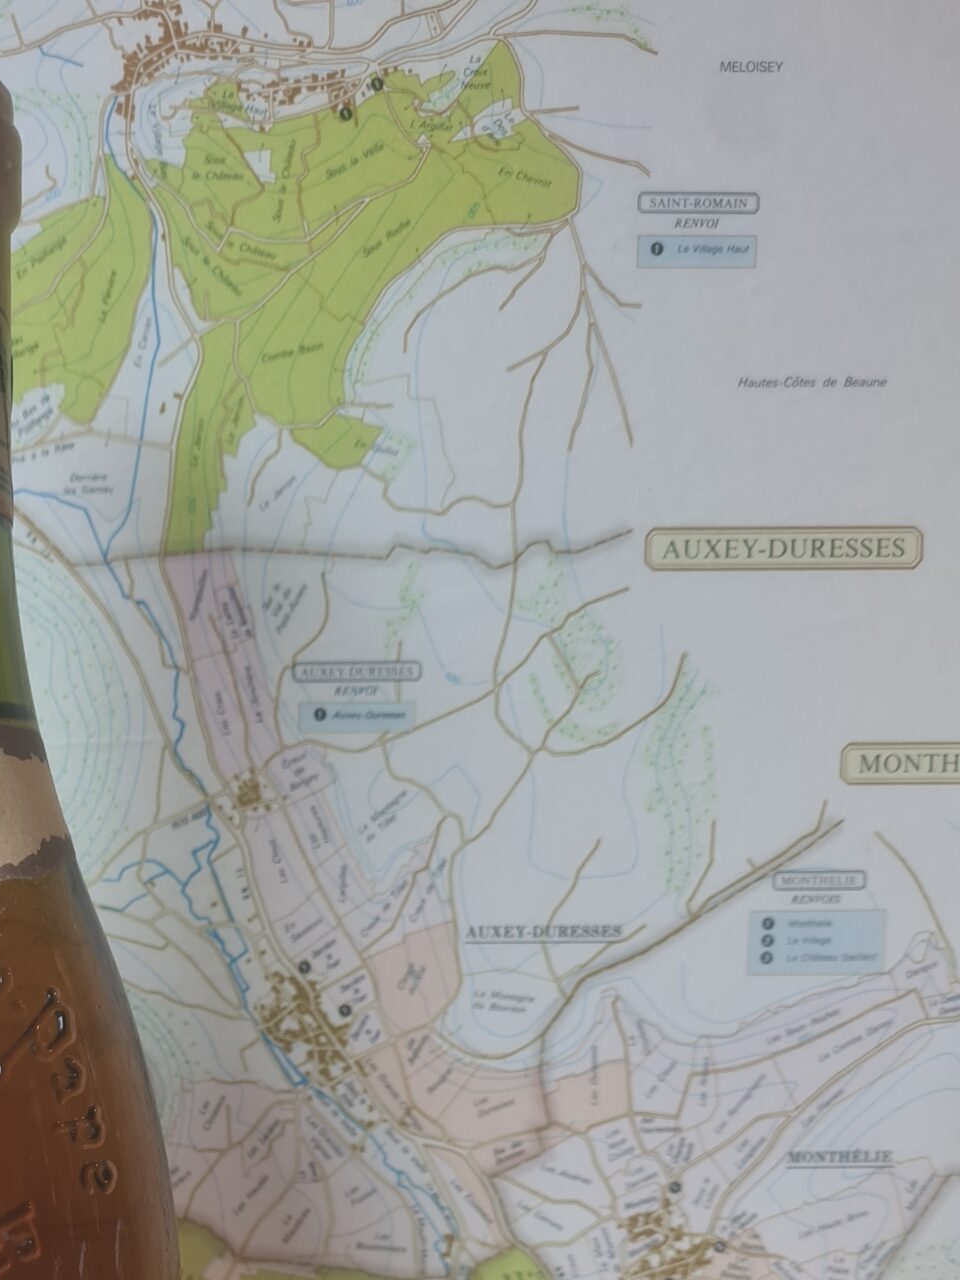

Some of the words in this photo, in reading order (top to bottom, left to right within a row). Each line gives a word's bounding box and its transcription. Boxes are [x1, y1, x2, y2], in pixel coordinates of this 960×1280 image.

[720, 60, 784, 73] MELOISEY
[649, 197, 748, 210] SAINT-ROMAIN
[674, 217, 721, 229] RENVOI
[692, 244, 725, 256] Village
[726, 244, 750, 254] Haut
[738, 376, 816, 389] Hautes-Côtes
[822, 376, 838, 388] de
[843, 376, 888, 388] Beaune
[661, 536, 907, 561] AUXEY-DURESSES
[300, 666, 415, 678] AUXEY-DURESSES
[464, 924, 623, 939] AUXEY-DURESSES
[788, 1149, 893, 1164] MONTHÉLIE
